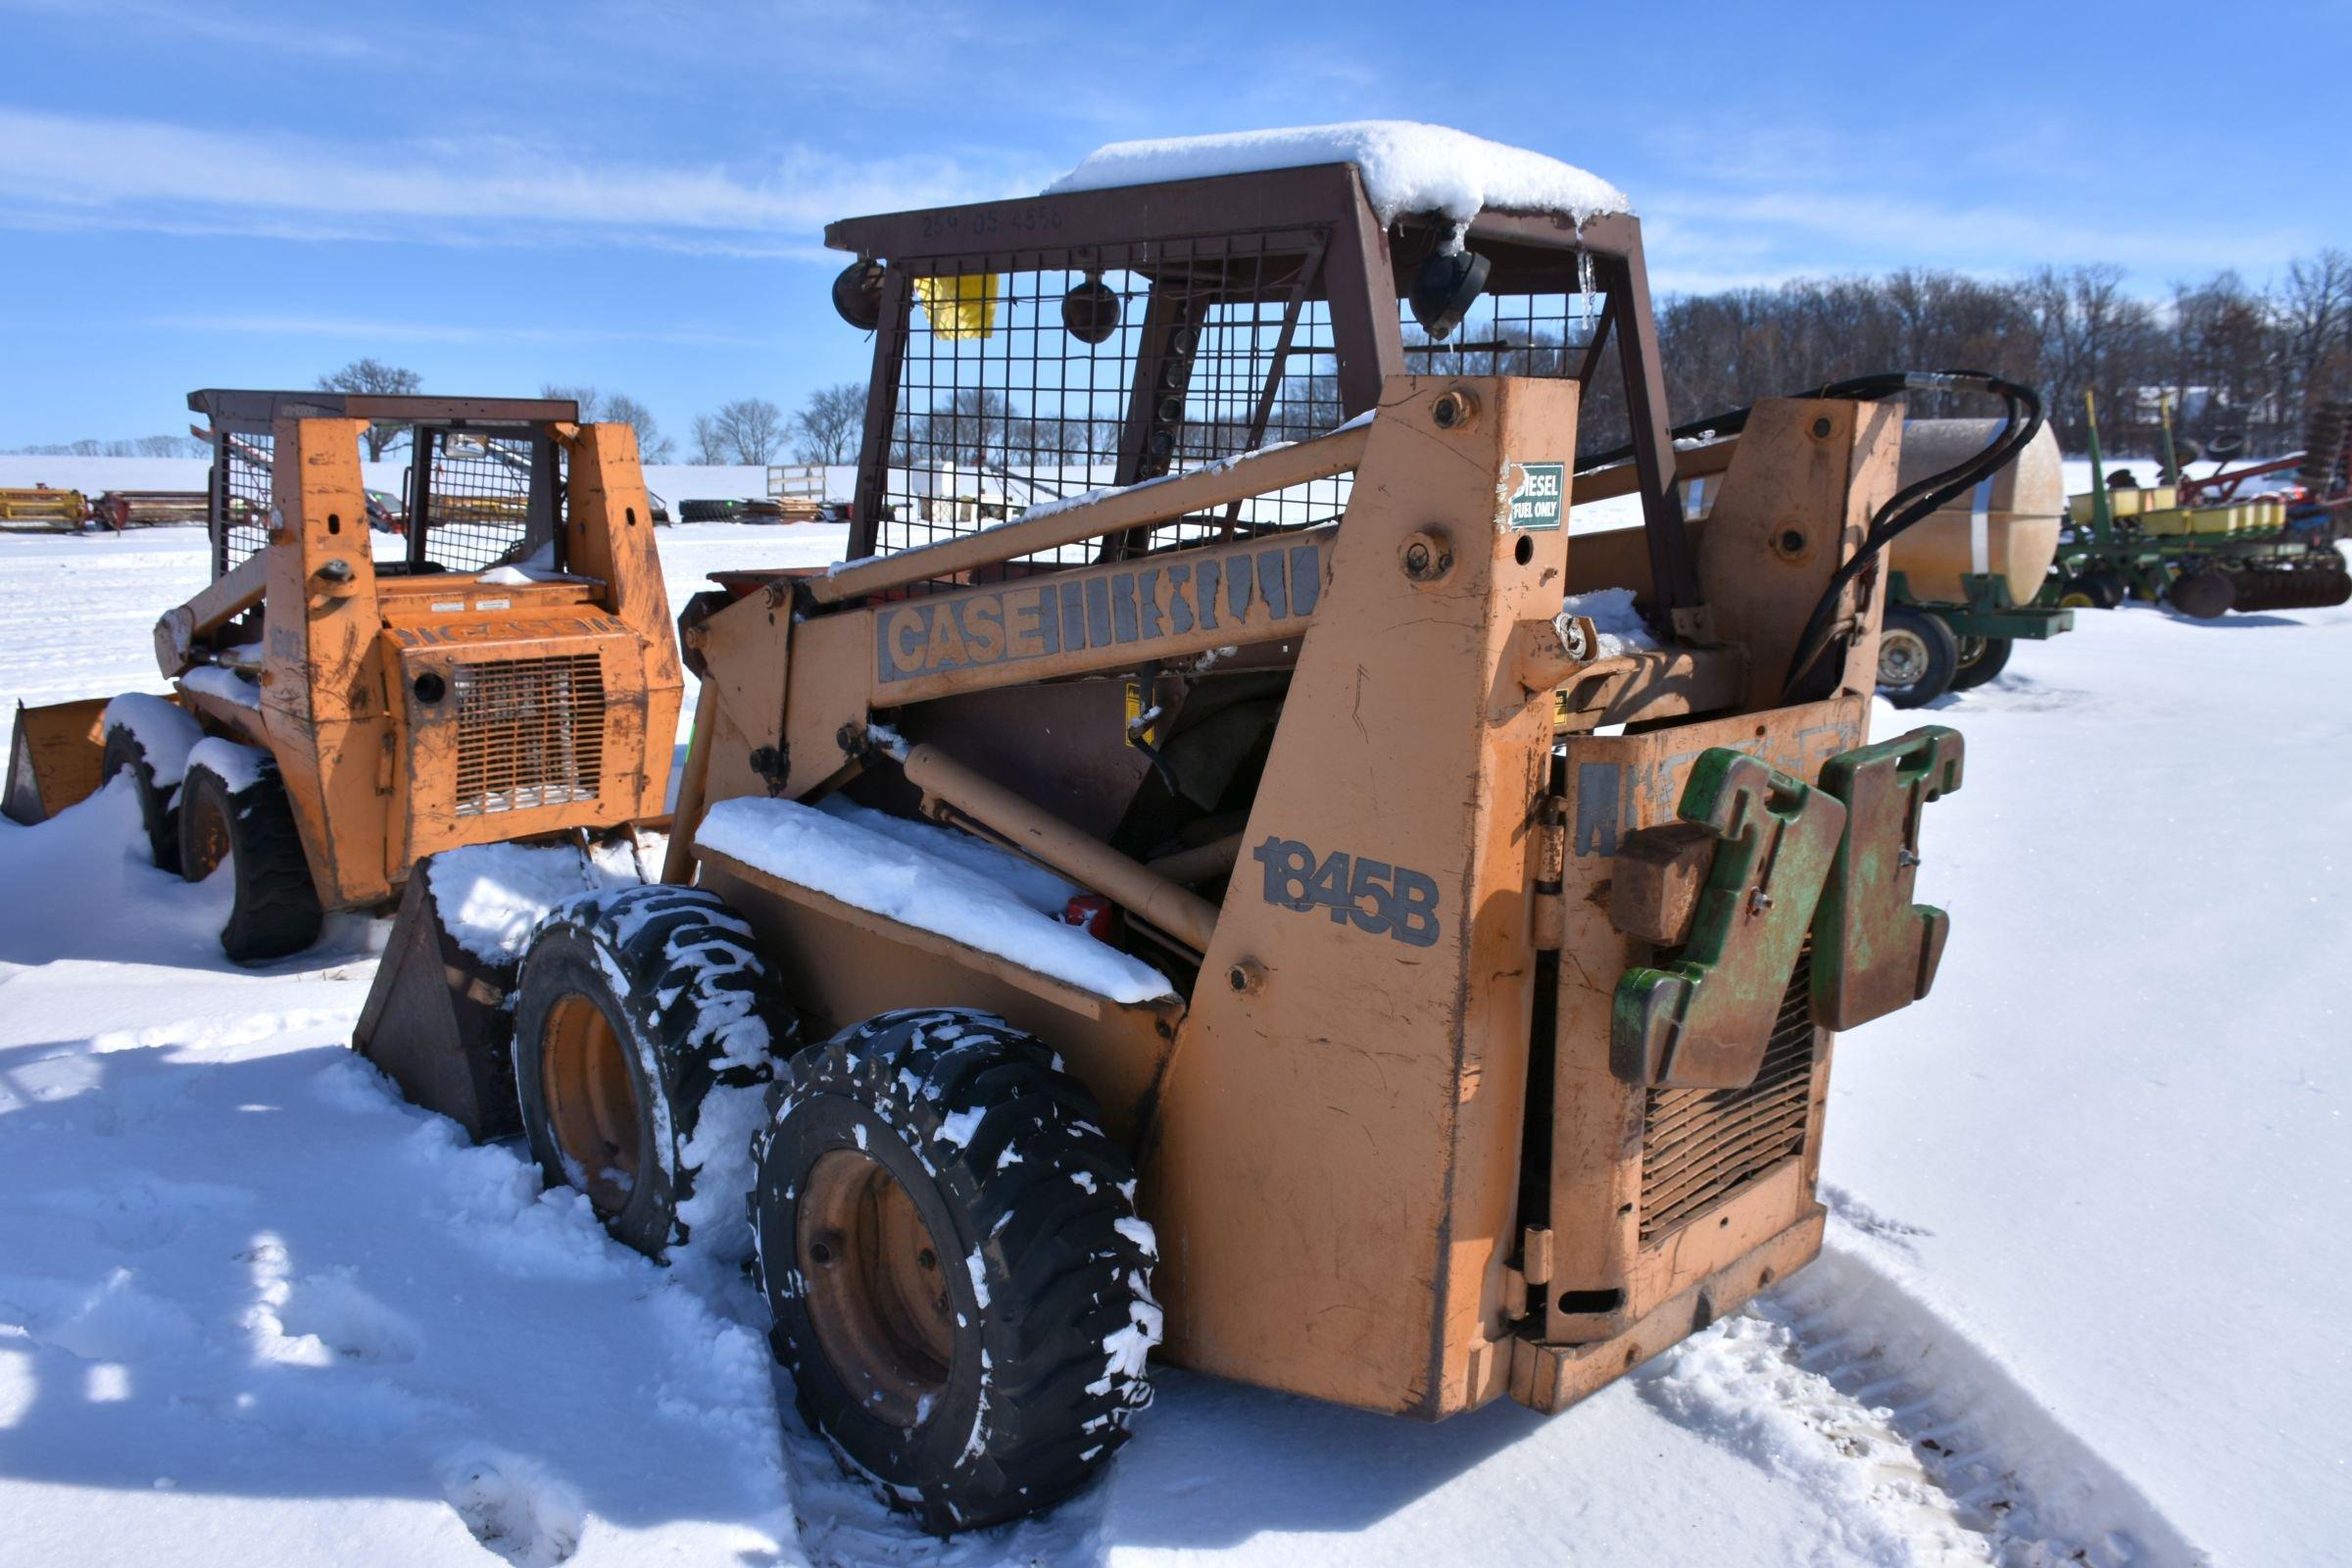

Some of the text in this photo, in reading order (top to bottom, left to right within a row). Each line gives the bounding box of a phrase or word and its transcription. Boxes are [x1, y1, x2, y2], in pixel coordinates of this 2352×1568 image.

[1514, 501, 1556, 518] FUEL ONLY
[888, 588, 1045, 672] CASE
[1253, 836, 1441, 948] 1845B
